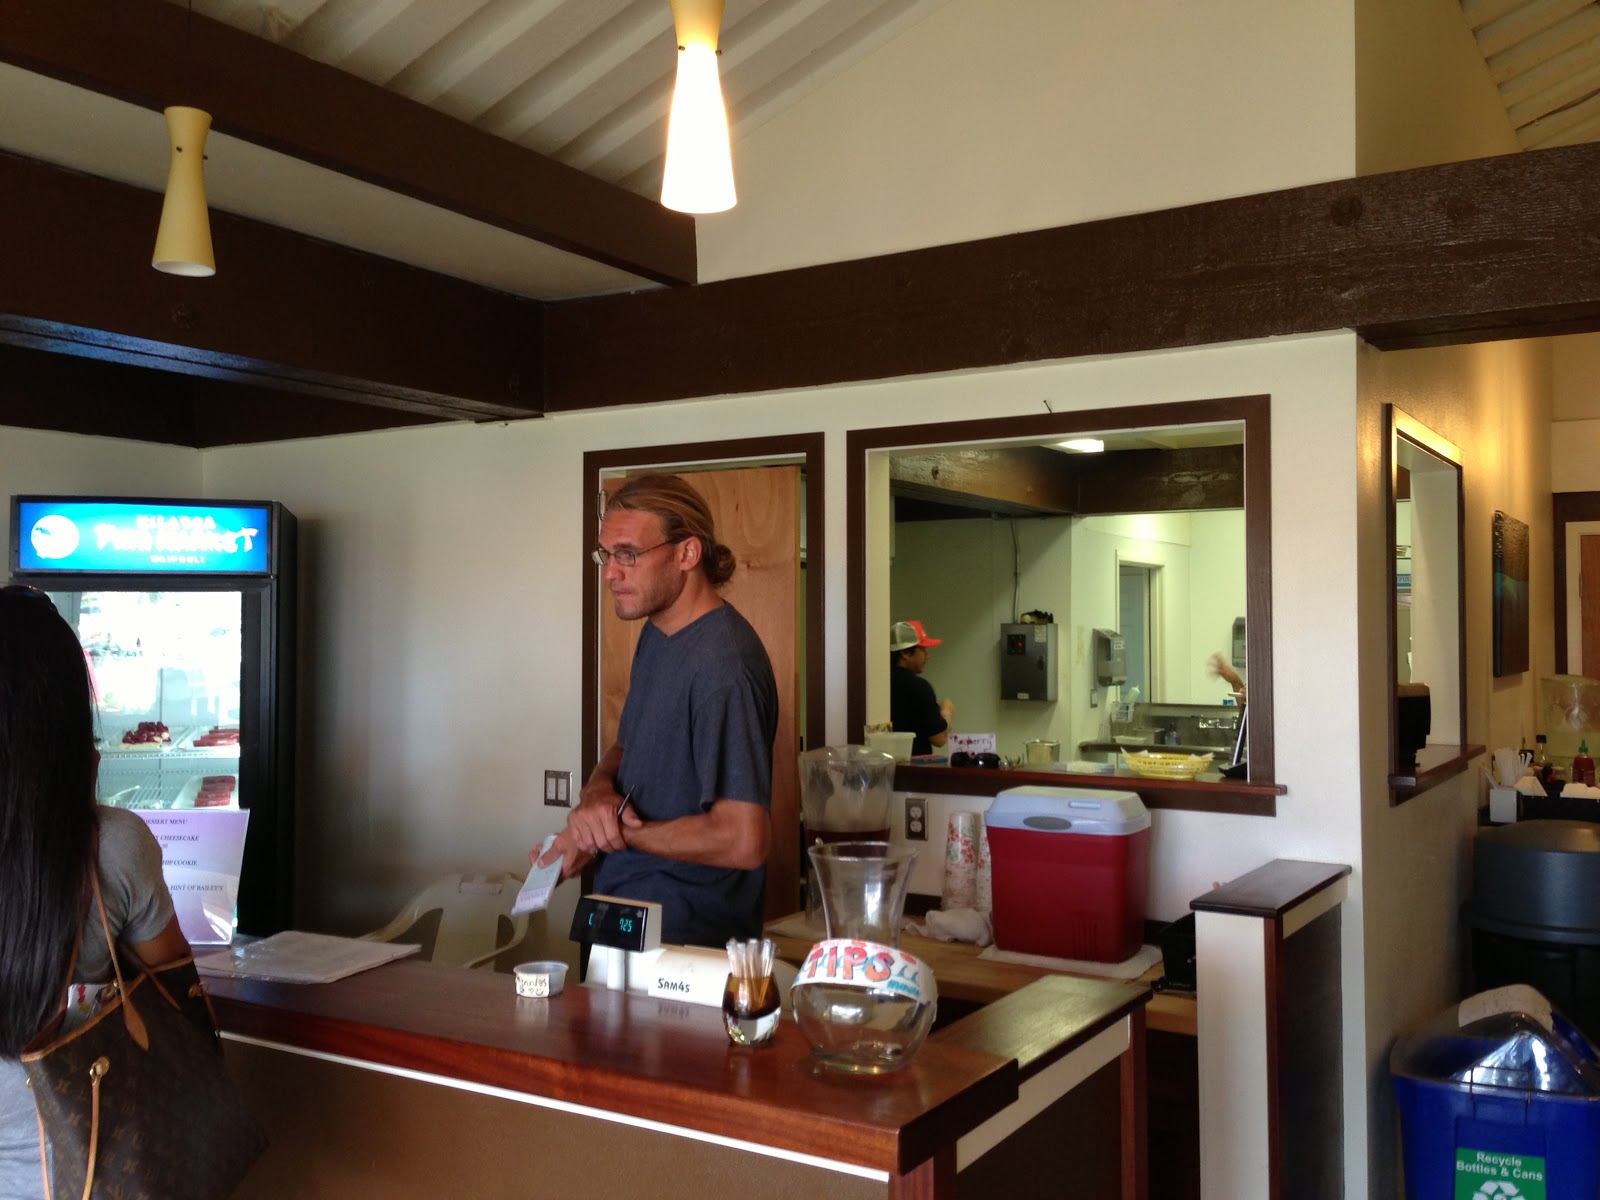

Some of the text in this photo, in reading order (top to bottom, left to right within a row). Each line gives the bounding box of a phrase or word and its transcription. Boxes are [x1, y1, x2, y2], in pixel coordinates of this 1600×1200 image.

[807, 946, 894, 982] TIPS
[1476, 1151, 1522, 1168] Recycle
[1456, 1160, 1543, 1182] Bottles & Cans
